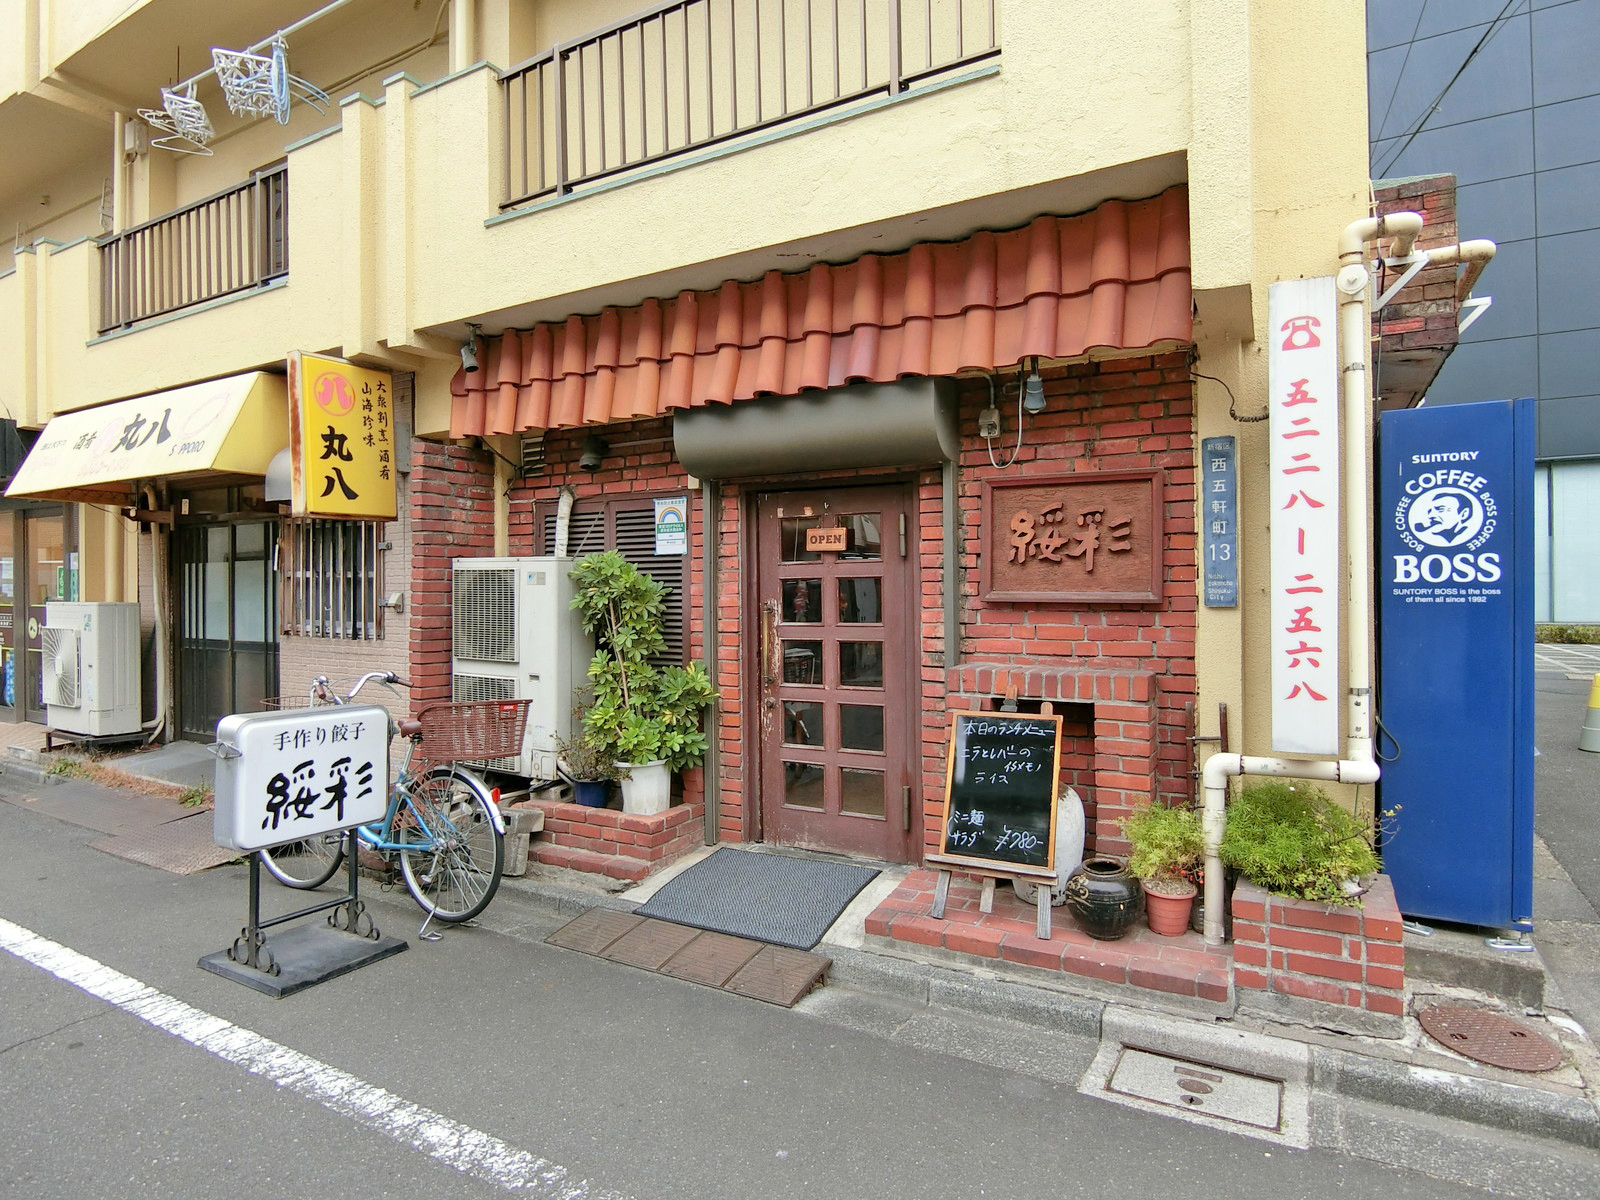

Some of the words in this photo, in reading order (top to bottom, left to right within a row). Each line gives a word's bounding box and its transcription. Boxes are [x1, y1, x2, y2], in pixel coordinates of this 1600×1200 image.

[361, 381, 376, 447] 山海珍味
[110, 408, 172, 453] 丸八
[168, 440, 205, 456] SPPORO
[320, 425, 359, 500] 丸八
[1405, 469, 1488, 495] COFFEE
[1211, 457, 1228, 534] 西五軒町
[1479, 491, 1497, 517] BOSS
[1395, 495, 1411, 531] COFFEE
[810, 534, 842, 544] OPEN
[1400, 531, 1424, 552] BOSS
[1466, 519, 1496, 551] COFFEE
[1209, 543, 1231, 561] 13
[1393, 553, 1501, 583] BOSS
[273, 722, 366, 751] 手作り餃子
[963, 720, 1055, 736] 本日のランチメニュー
[961, 744, 1031, 761] ニラとレバーの
[975, 772, 1009, 784] ライス
[951, 830, 985, 847] サラダ
